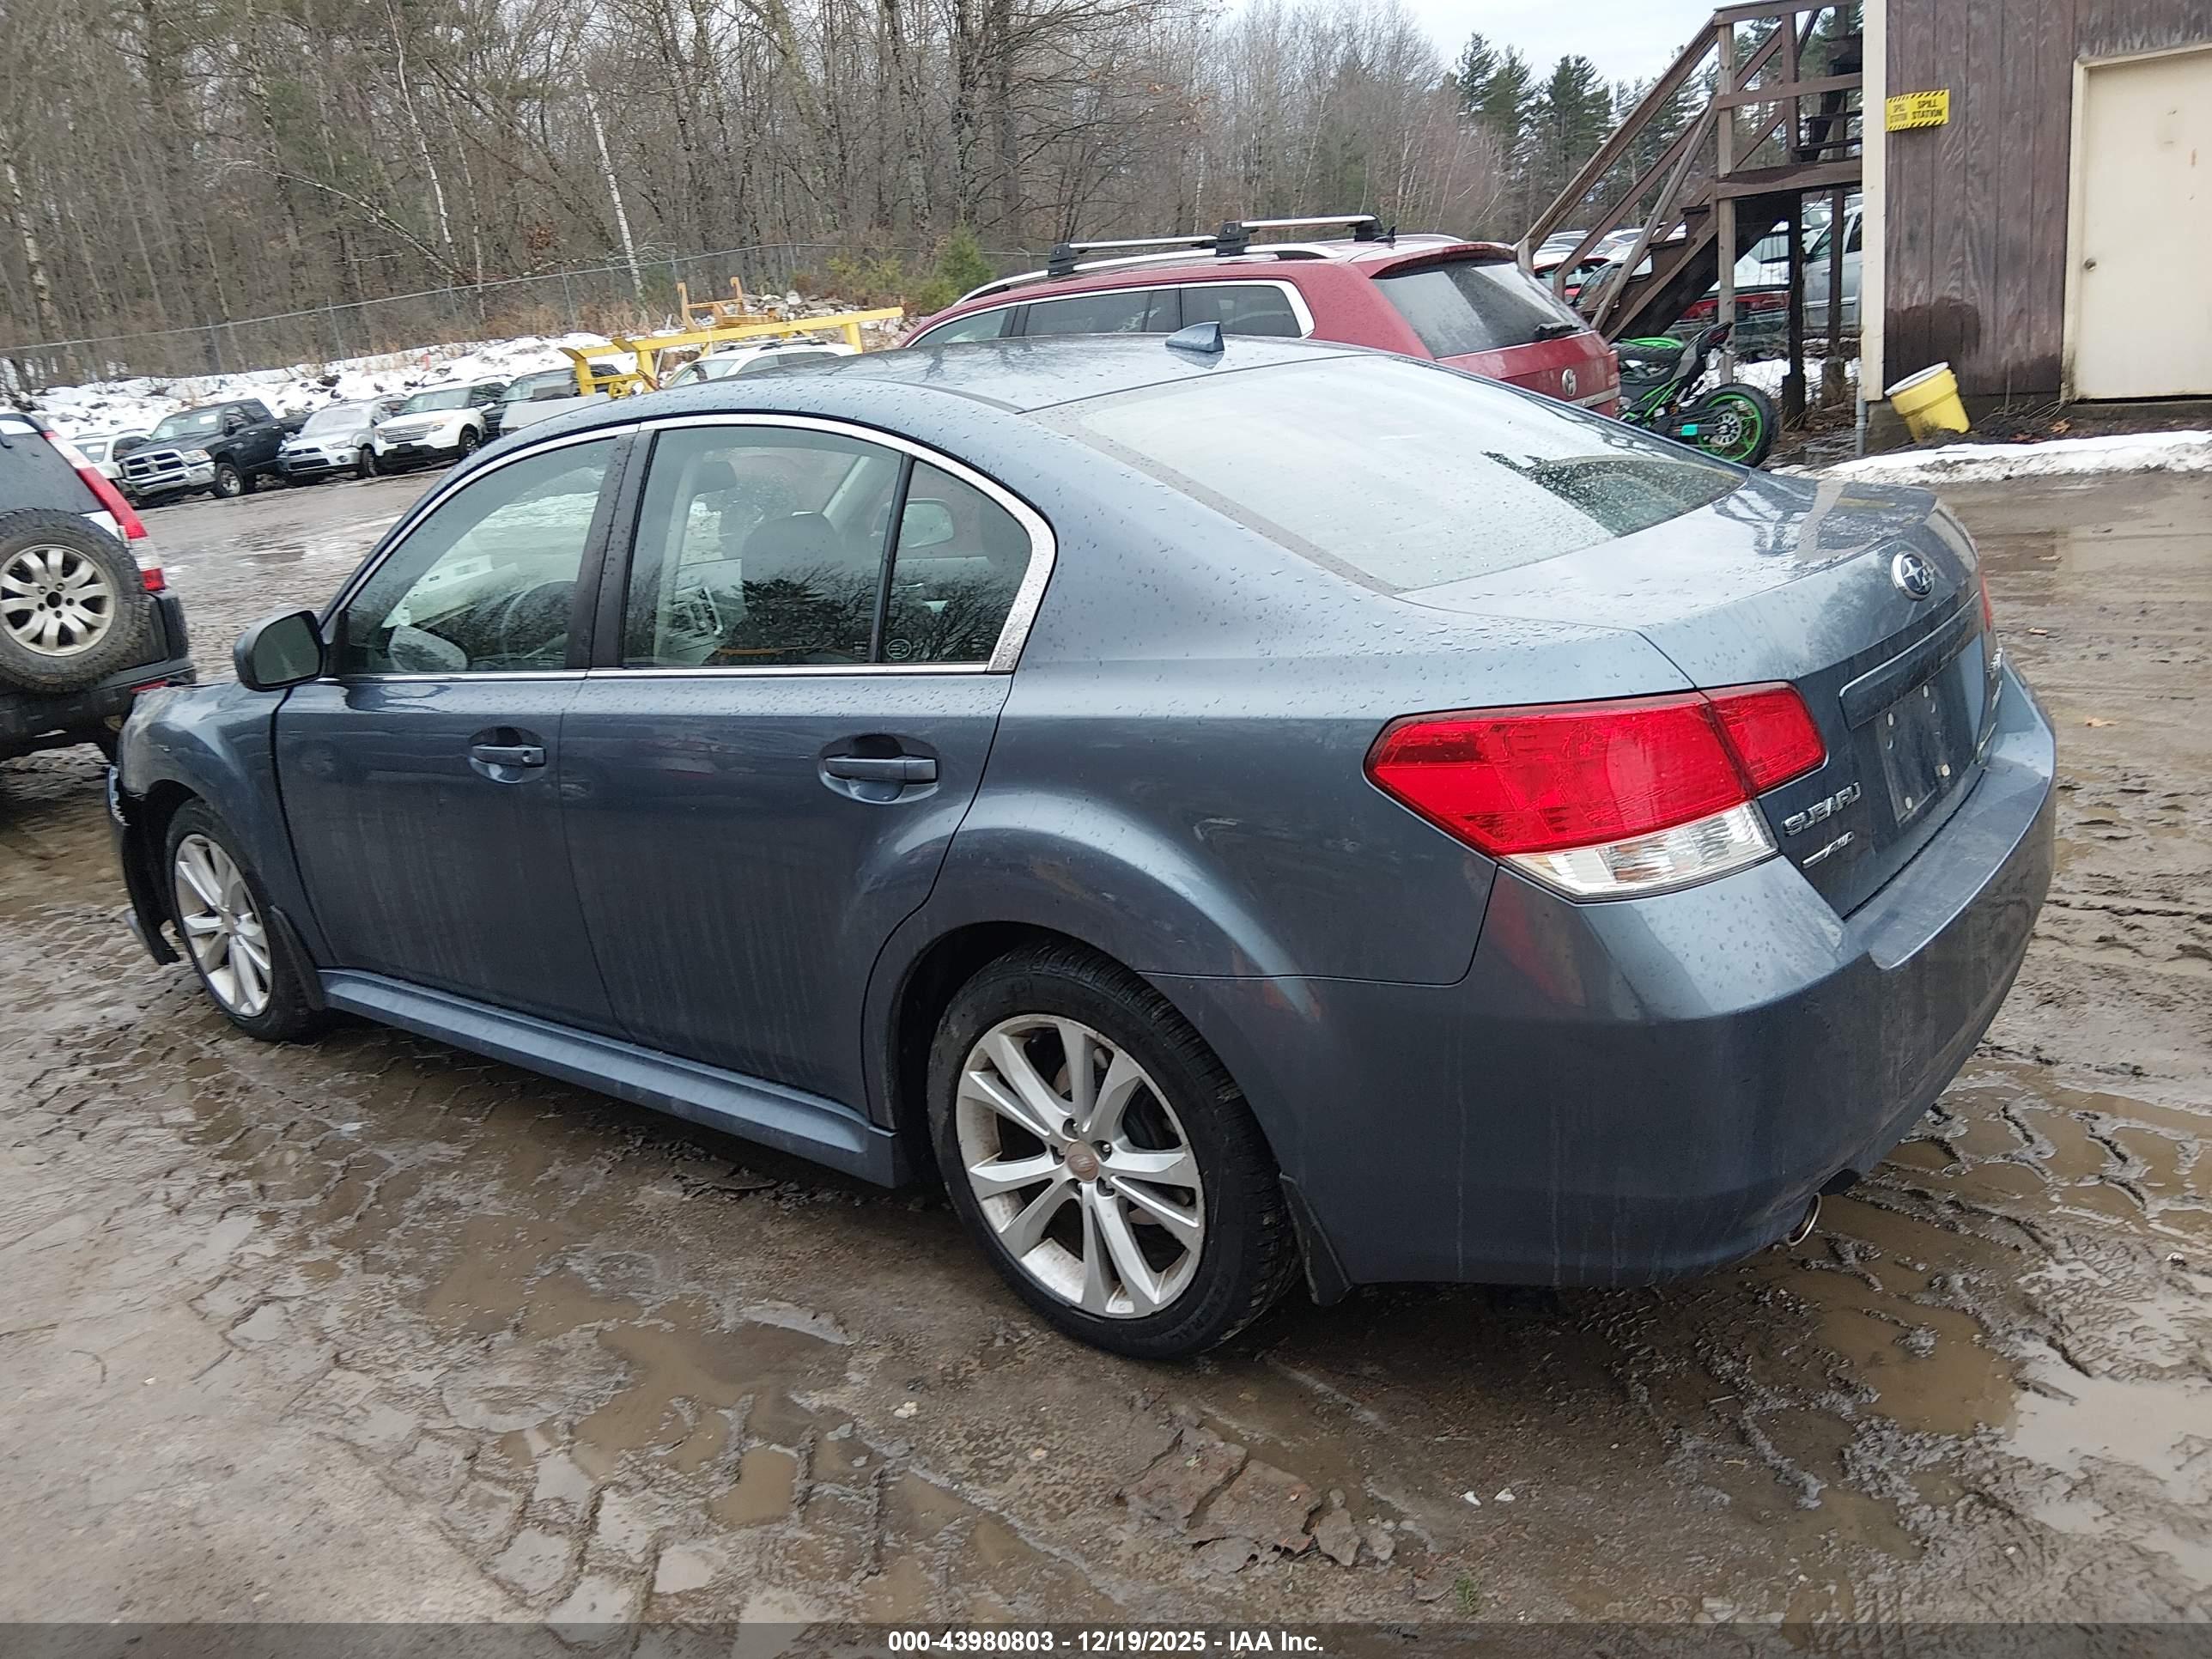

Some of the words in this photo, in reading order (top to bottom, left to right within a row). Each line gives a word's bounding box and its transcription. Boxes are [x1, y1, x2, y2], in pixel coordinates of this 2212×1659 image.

[1917, 99, 1938, 109] SPILL
[1911, 109, 1943, 119] STATION
[1782, 781, 1862, 837] SUBARU
